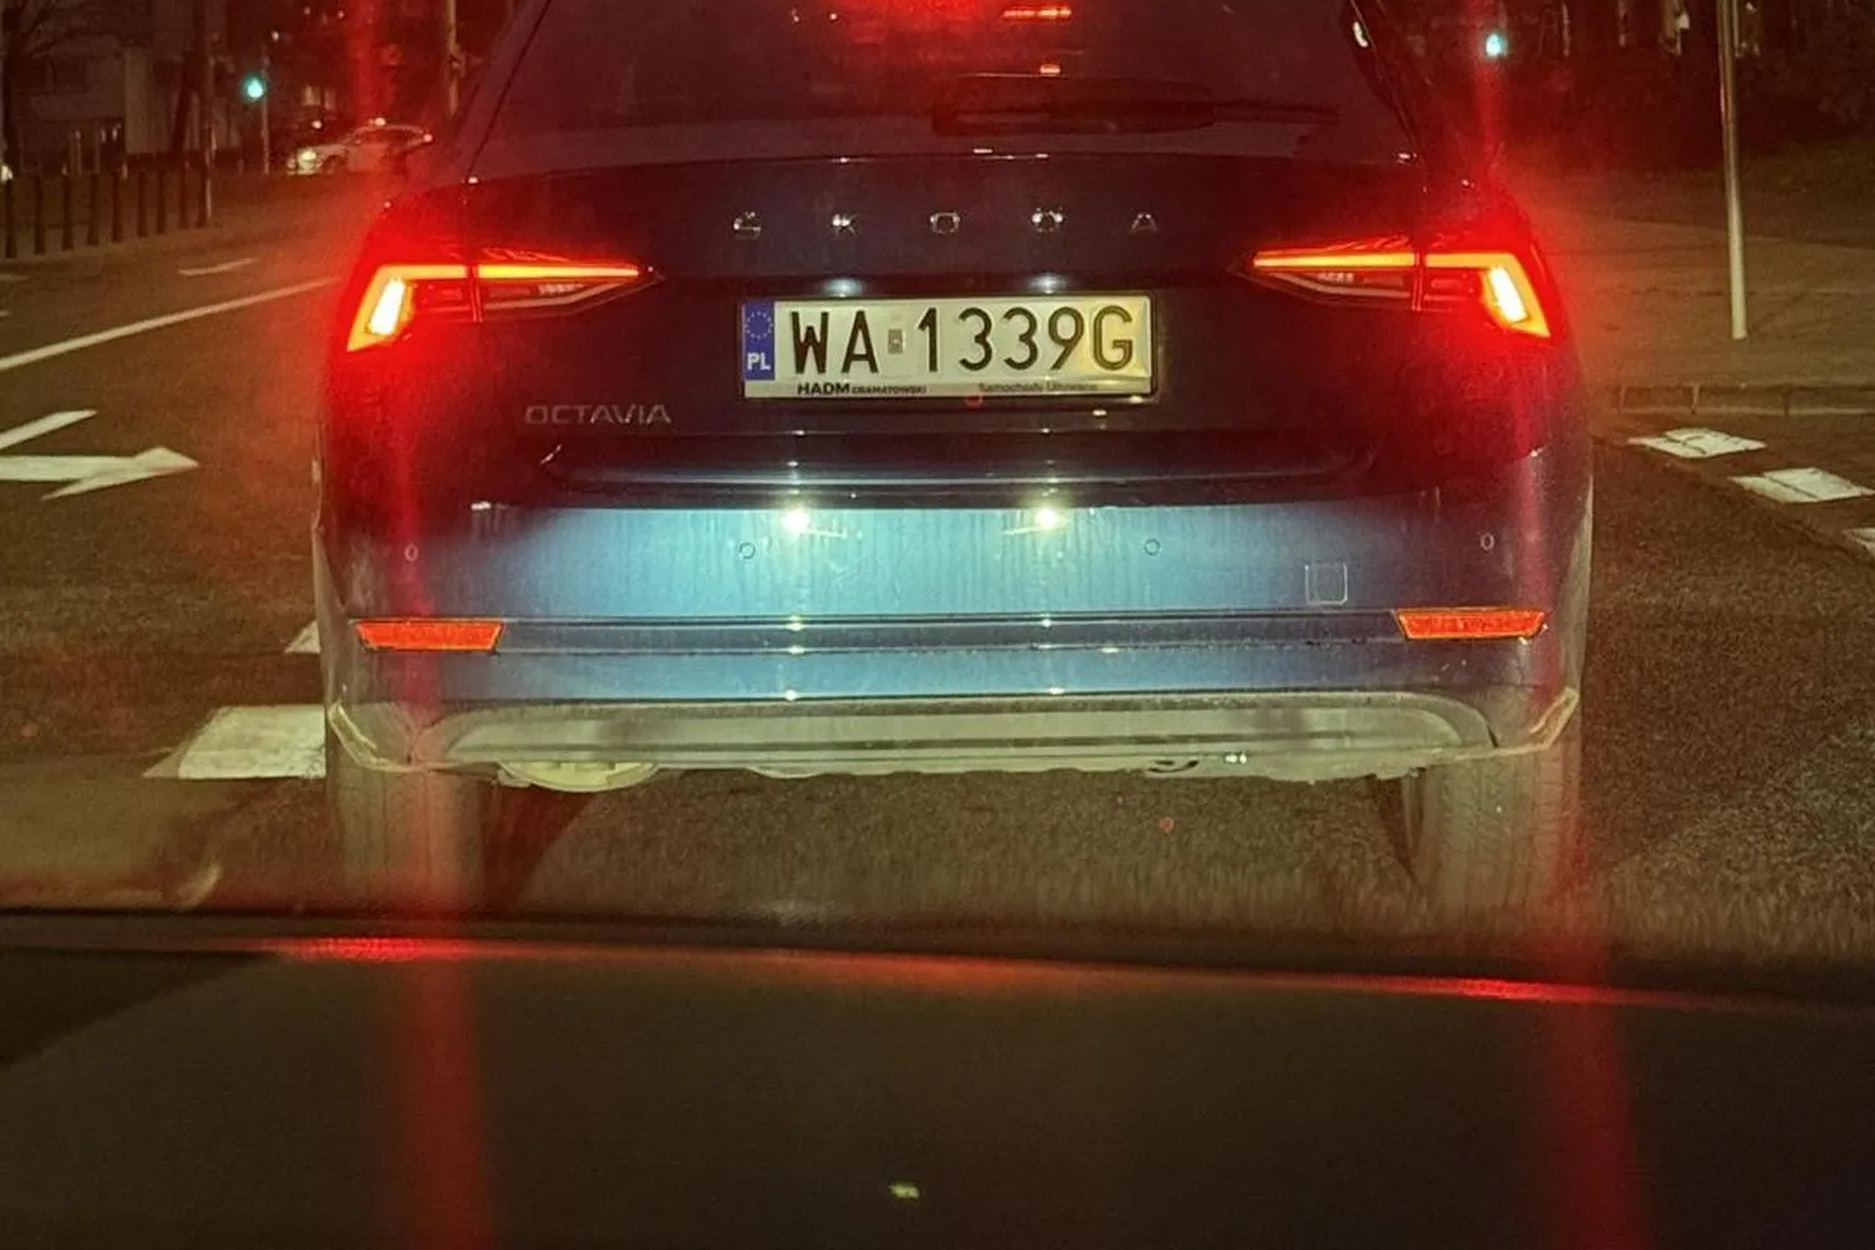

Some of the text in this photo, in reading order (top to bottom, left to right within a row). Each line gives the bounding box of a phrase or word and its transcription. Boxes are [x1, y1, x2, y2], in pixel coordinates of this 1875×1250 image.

[791, 305, 1134, 374] WA 1339G
[747, 352, 771, 371] PL
[797, 382, 850, 395] HADM
[525, 404, 672, 425] OCTAVIA
